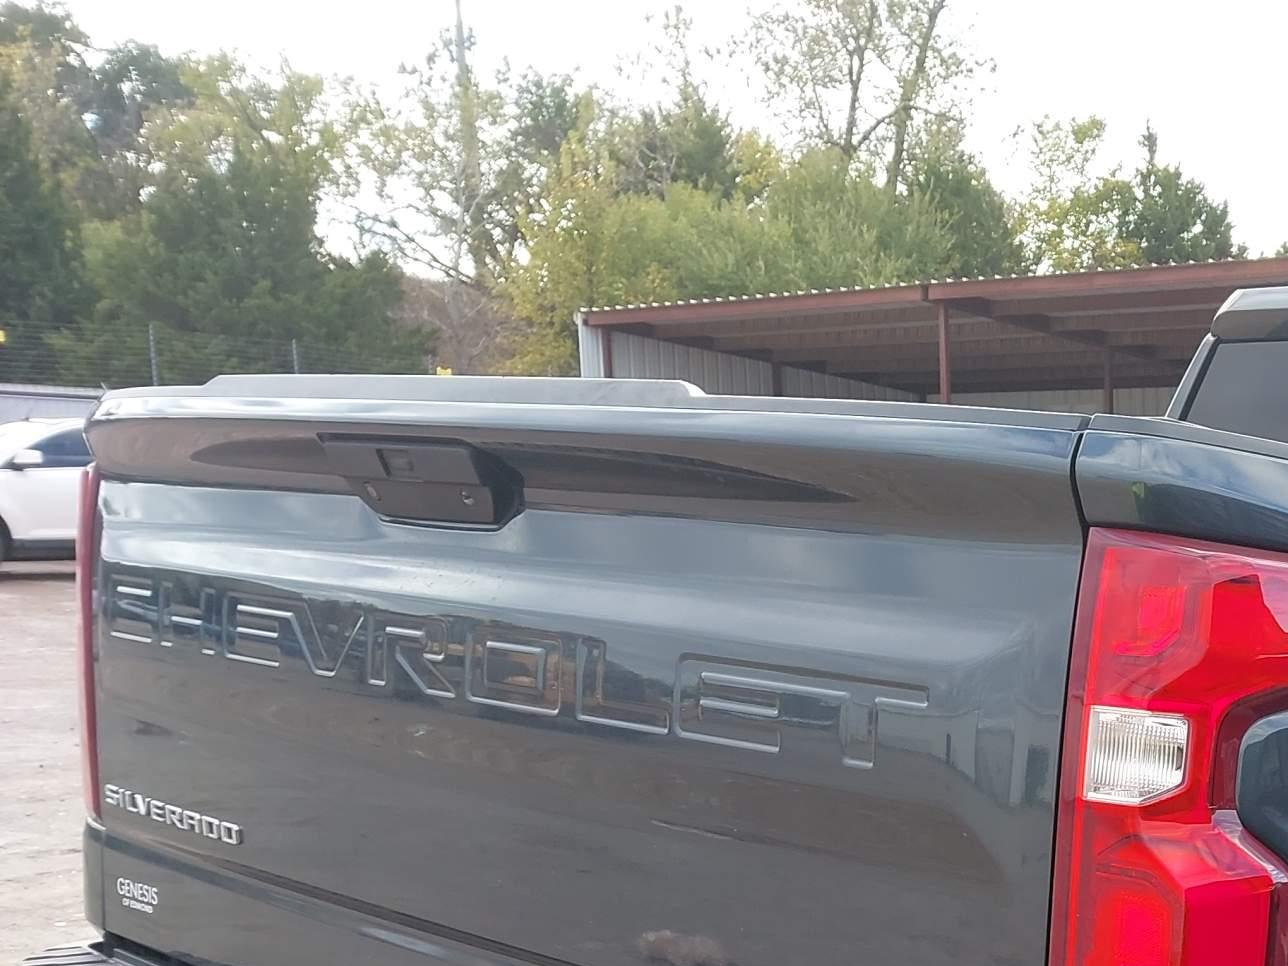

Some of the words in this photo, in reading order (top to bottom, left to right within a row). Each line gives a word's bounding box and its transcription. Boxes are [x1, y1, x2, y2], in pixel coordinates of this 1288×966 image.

[108, 573, 931, 770] CHEVROLET
[104, 783, 241, 845] SILVERADO
[116, 877, 158, 905] GENESIS
